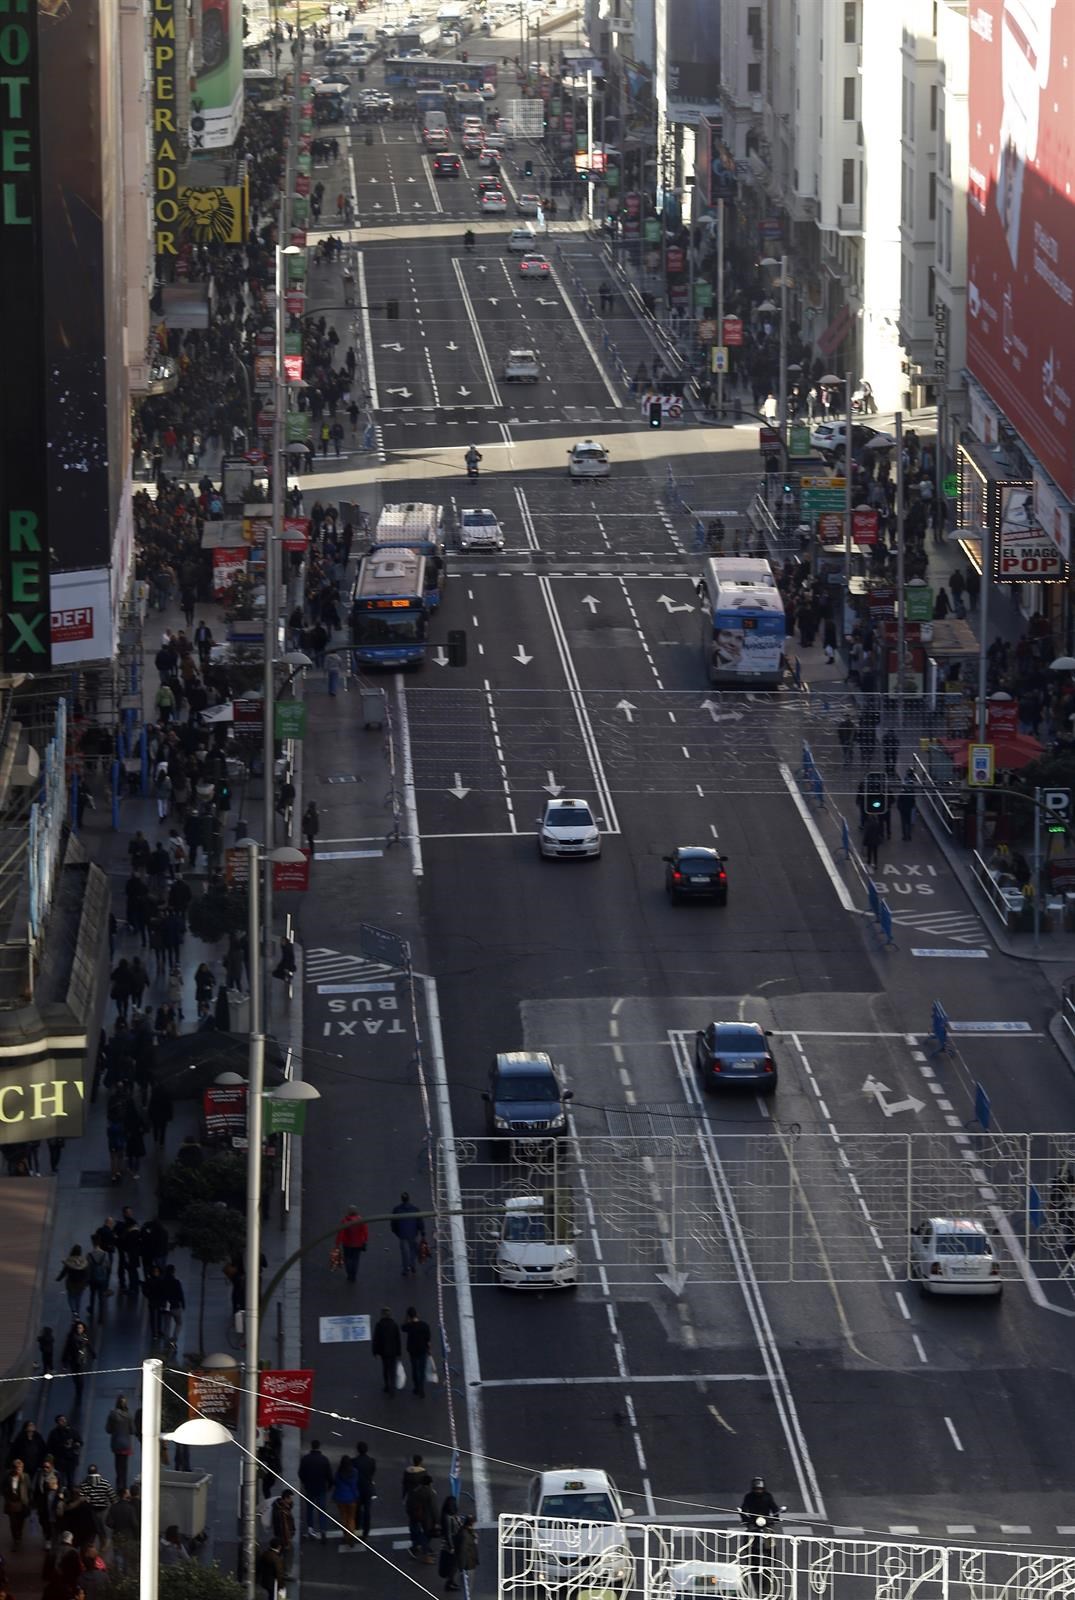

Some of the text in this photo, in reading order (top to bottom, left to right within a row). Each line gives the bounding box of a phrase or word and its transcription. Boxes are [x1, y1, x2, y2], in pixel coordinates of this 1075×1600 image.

[934, 303, 945, 358] HOSTAL
[1003, 548, 1058, 558] EL MAGO
[1003, 558, 1058, 572] POP
[7, 509, 46, 654] REX
[50, 608, 91, 628] DEFI
[874, 882, 936, 895] BUS
[327, 996, 399, 1013] BUS
[322, 1018, 407, 1037] TAXI
